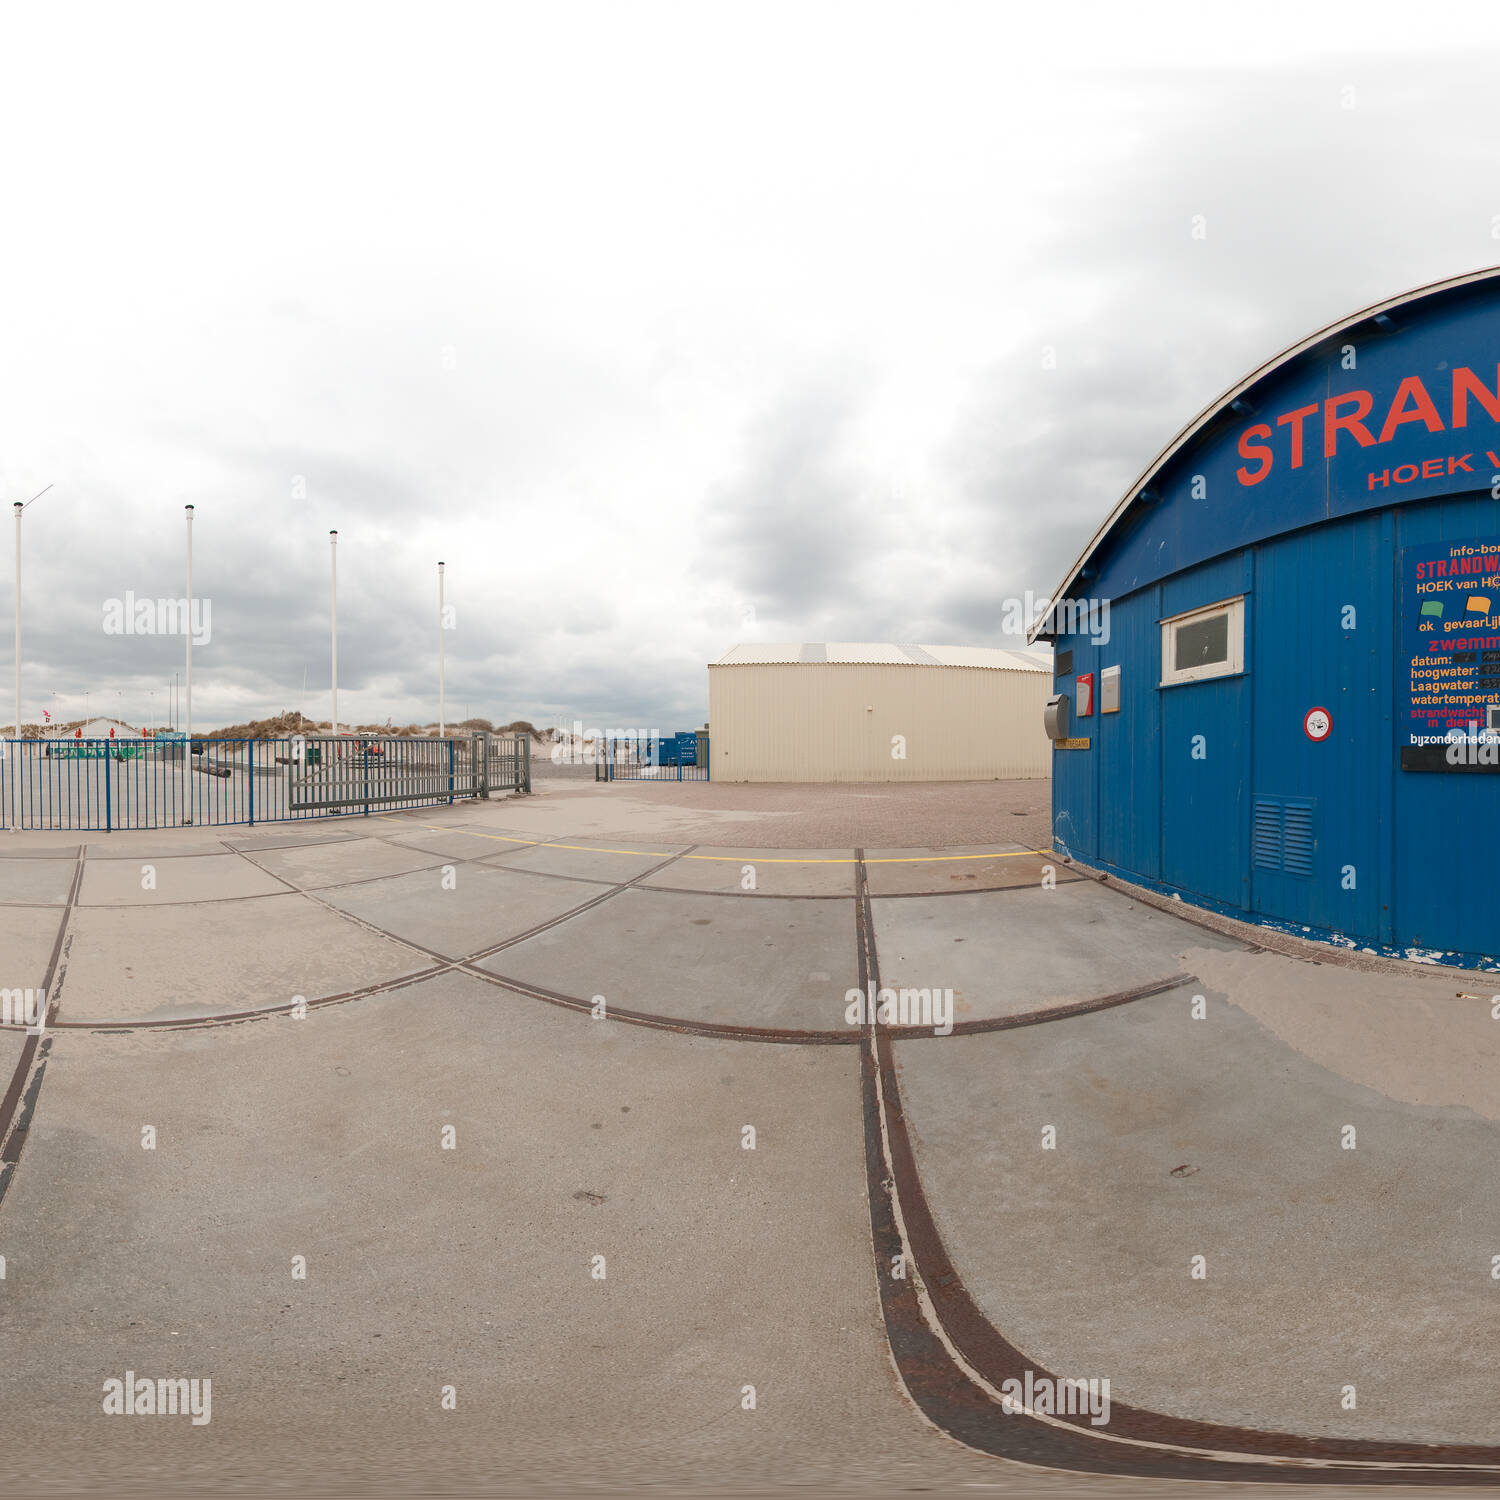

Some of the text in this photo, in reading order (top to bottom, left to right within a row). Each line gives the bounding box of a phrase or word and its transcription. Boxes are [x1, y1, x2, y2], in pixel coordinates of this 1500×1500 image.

[1368, 454, 1473, 491] HOEK
[1416, 579, 1453, 594] HOEK
[1456, 579, 1478, 590] van
[1419, 621, 1433, 632] ok
[1411, 655, 1452, 667] datum:
[1411, 665, 1479, 680] hoogwater:
[1411, 679, 1479, 694] Laagwater:
[1411, 706, 1485, 718] strandwacht
[1428, 718, 1485, 728] in dienst
